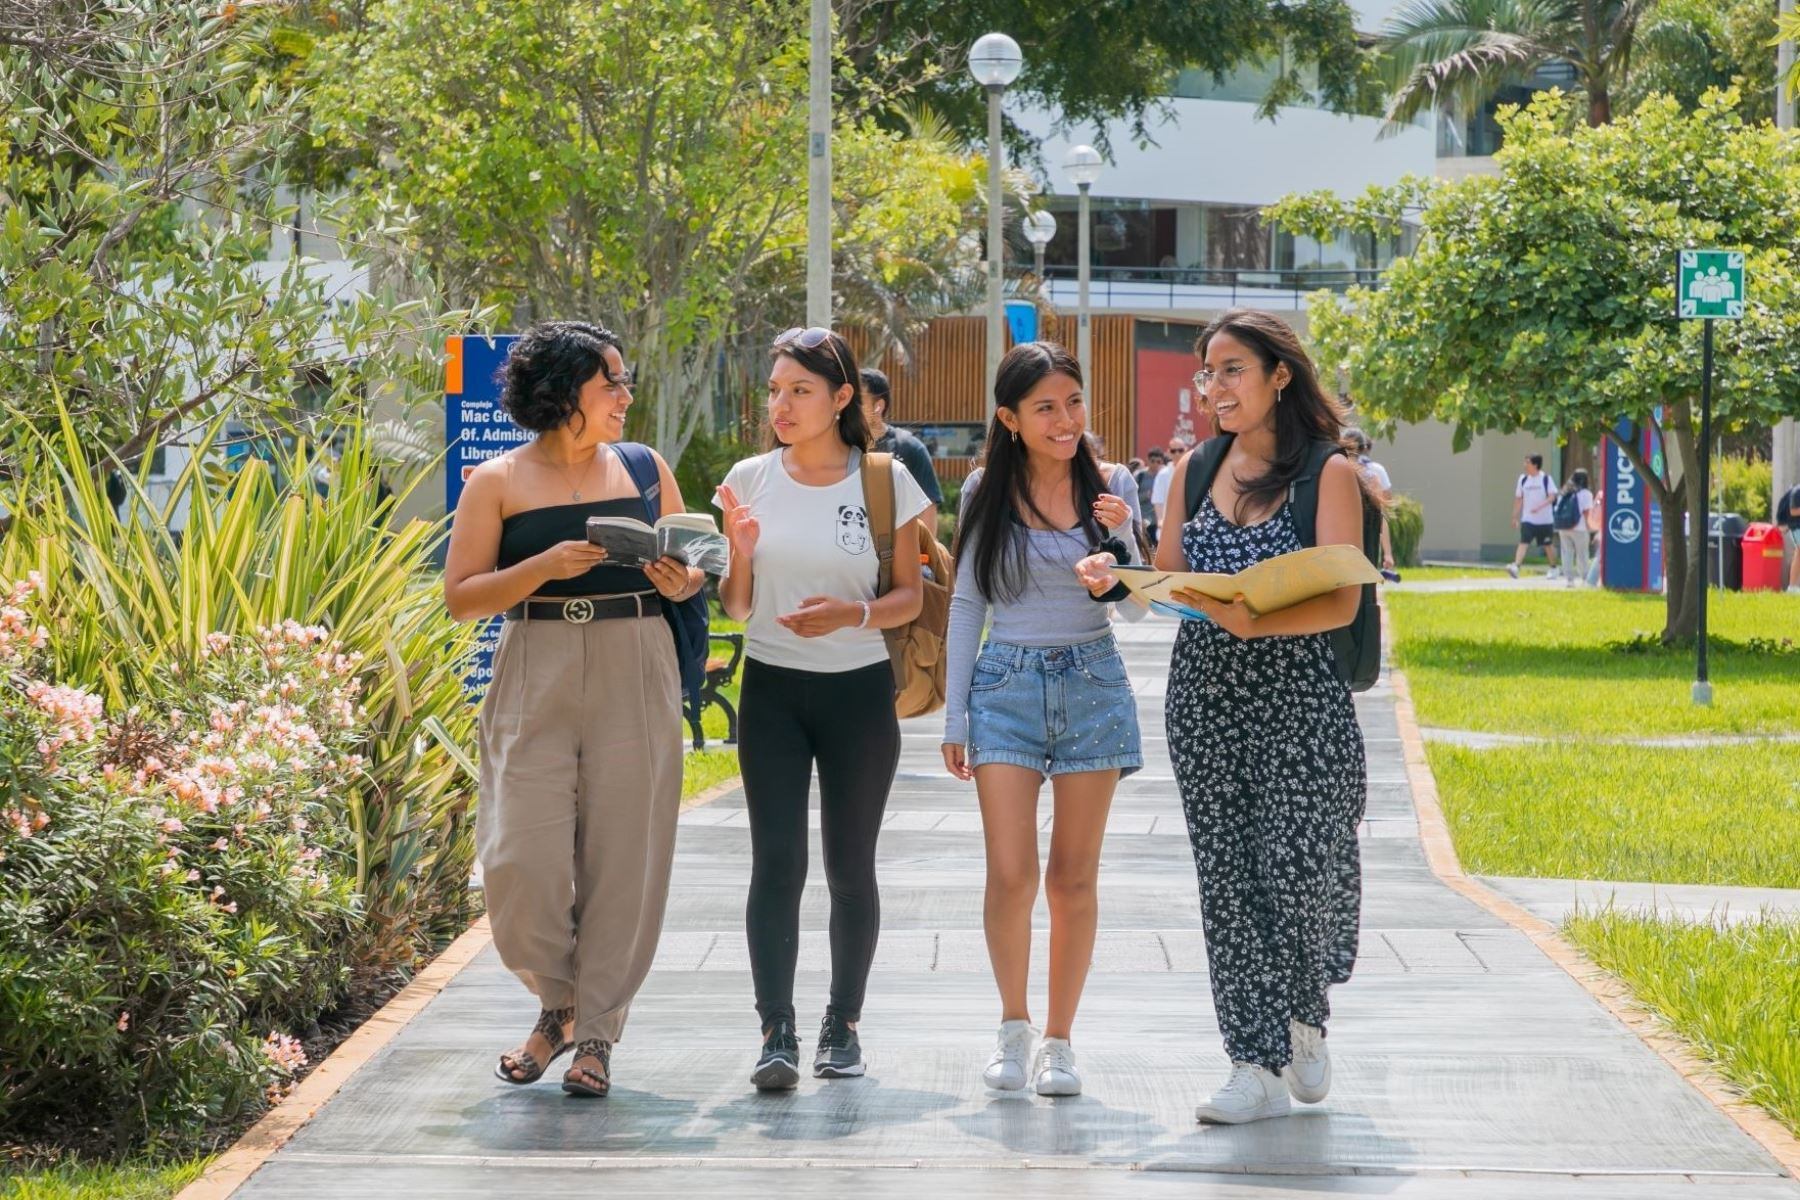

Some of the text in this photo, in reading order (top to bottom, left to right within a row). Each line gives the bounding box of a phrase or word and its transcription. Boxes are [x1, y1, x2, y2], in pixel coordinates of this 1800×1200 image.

[461, 400, 493, 409] Complejo
[461, 409, 516, 423] Mac Gre
[460, 428, 480, 441] Of.
[461, 445, 508, 460] Librerí
